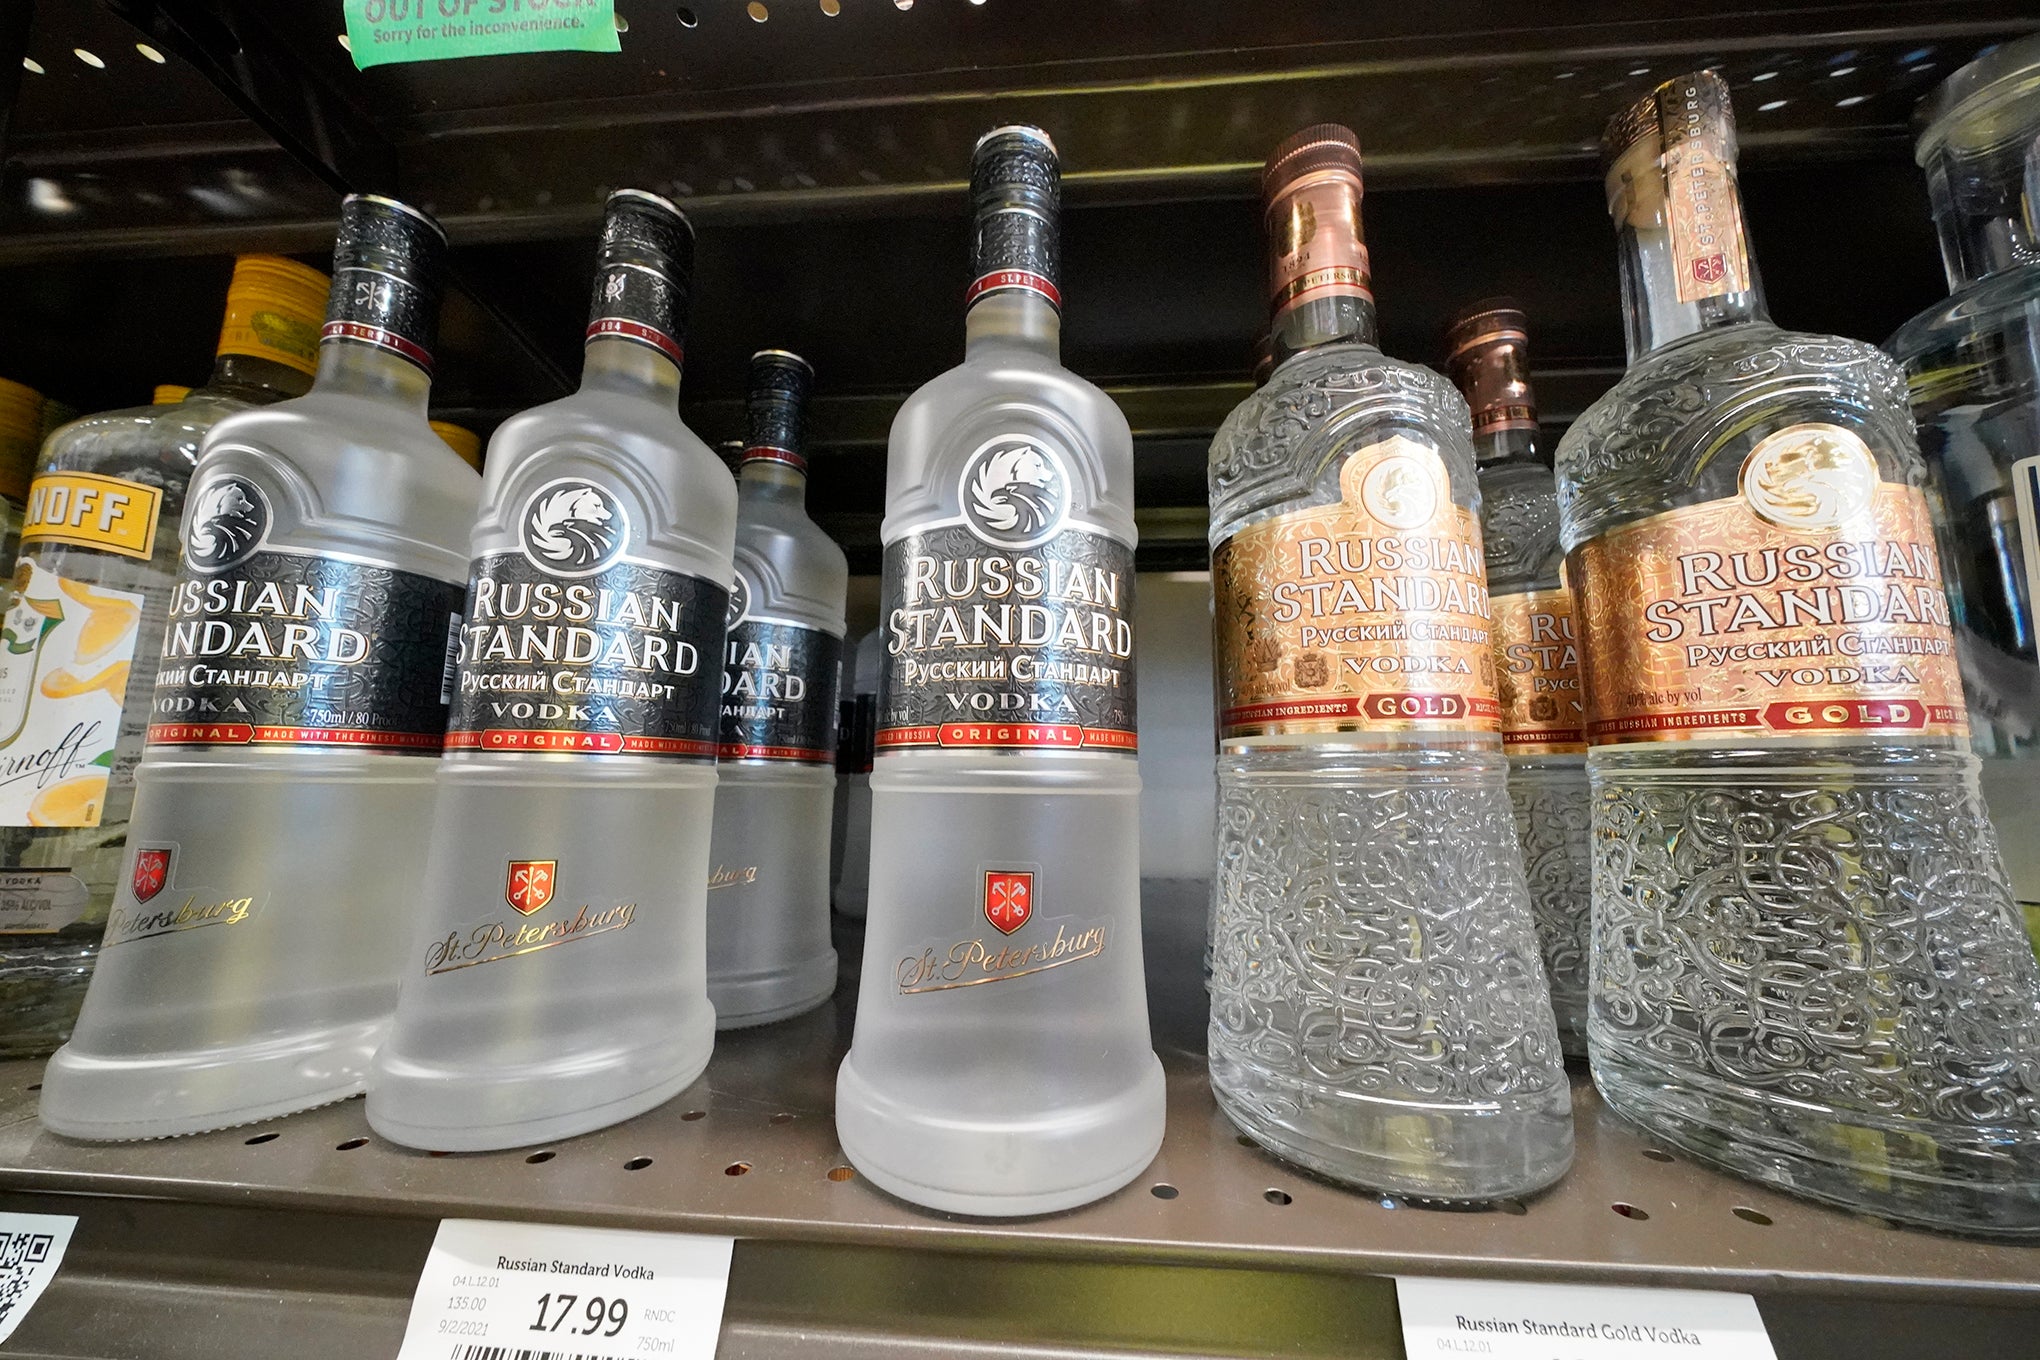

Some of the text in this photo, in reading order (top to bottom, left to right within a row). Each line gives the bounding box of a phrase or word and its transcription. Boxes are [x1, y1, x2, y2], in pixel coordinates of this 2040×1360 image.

[373, 15, 585, 44] Sorry for the inconvenience.
[24, 486, 131, 532] NOFF
[1299, 536, 1483, 579] RUSSIAN
[1676, 541, 1935, 598] RUSSIAN
[909, 556, 1119, 612] RUSSIAN
[472, 577, 682, 634] RUSSIAN
[1272, 576, 1491, 624] STANDARD
[888, 604, 1133, 660] STANDARD
[1301, 620, 1409, 648] Русский
[456, 623, 699, 676] STANDARD
[729, 641, 793, 671] IAN
[1507, 643, 1578, 673] STA
[1687, 634, 1832, 668] Русский
[904, 657, 1008, 686] Русский
[1344, 655, 1473, 675] VODKA
[1755, 665, 1919, 688] VODKA
[460, 670, 549, 694] Русский
[945, 692, 1078, 712] VODKA
[1377, 697, 1458, 715] GOLD
[1666, 690, 1681, 706] by
[1684, 687, 1702, 702] vol
[310, 709, 346, 725] 750ml
[355, 711, 370, 725] 80
[491, 702, 620, 723] VODKA
[720, 705, 786, 719] АНДАРТ
[1275, 703, 1349, 717] INGREDIENTS
[1663, 712, 1748, 727] INGREDIENTS
[1784, 703, 1912, 724] GOLD
[263, 729, 295, 740] MADE
[299, 730, 330, 740] WITH
[334, 732, 355, 741] THE
[359, 733, 396, 743] FINEST
[492, 734, 611, 748] ORIGINAL
[631, 740, 654, 749] MADE
[904, 731, 931, 740] RUSSIA
[952, 728, 1072, 742] ORIGINAL
[1089, 732, 1109, 742] MADE
[104, 895, 253, 941] Petersburg
[425, 902, 638, 970] St. Petersburg
[897, 924, 1107, 990] St. Petersburg
[496, 1255, 655, 1281] Russian Standard Vodka
[447, 1293, 677, 1338] 135.00 17.99 RNDC
[437, 1319, 490, 1338] 9/2/2021
[1454, 1314, 1702, 1347] Russian Standard Gold Vodka
[635, 1335, 676, 1353] 750ml
